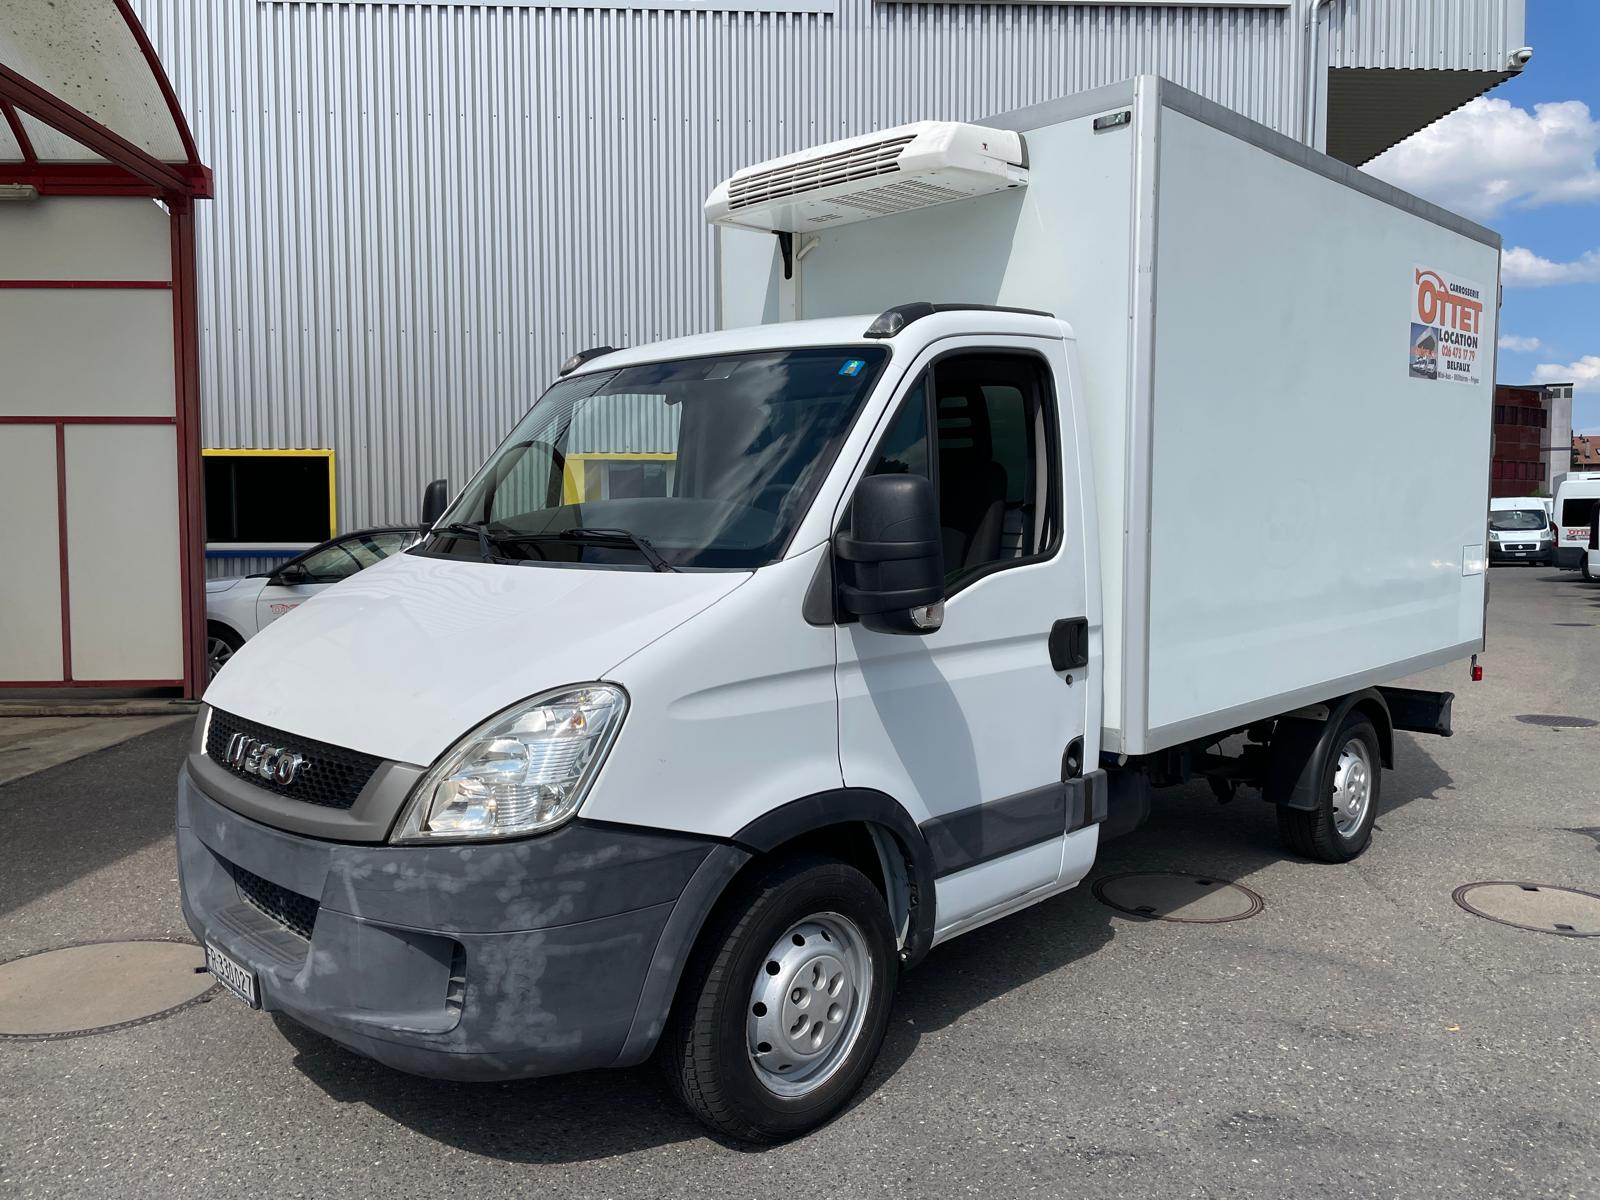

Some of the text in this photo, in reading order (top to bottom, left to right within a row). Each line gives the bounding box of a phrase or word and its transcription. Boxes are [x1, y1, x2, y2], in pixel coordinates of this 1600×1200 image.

[1450, 283, 1479, 299] CARROSSERIE
[1418, 280, 1482, 334] OTTET
[1439, 329, 1478, 349] LOCATION
[1447, 360, 1470, 372] BELFAUX
[227, 733, 302, 785] IVECO
